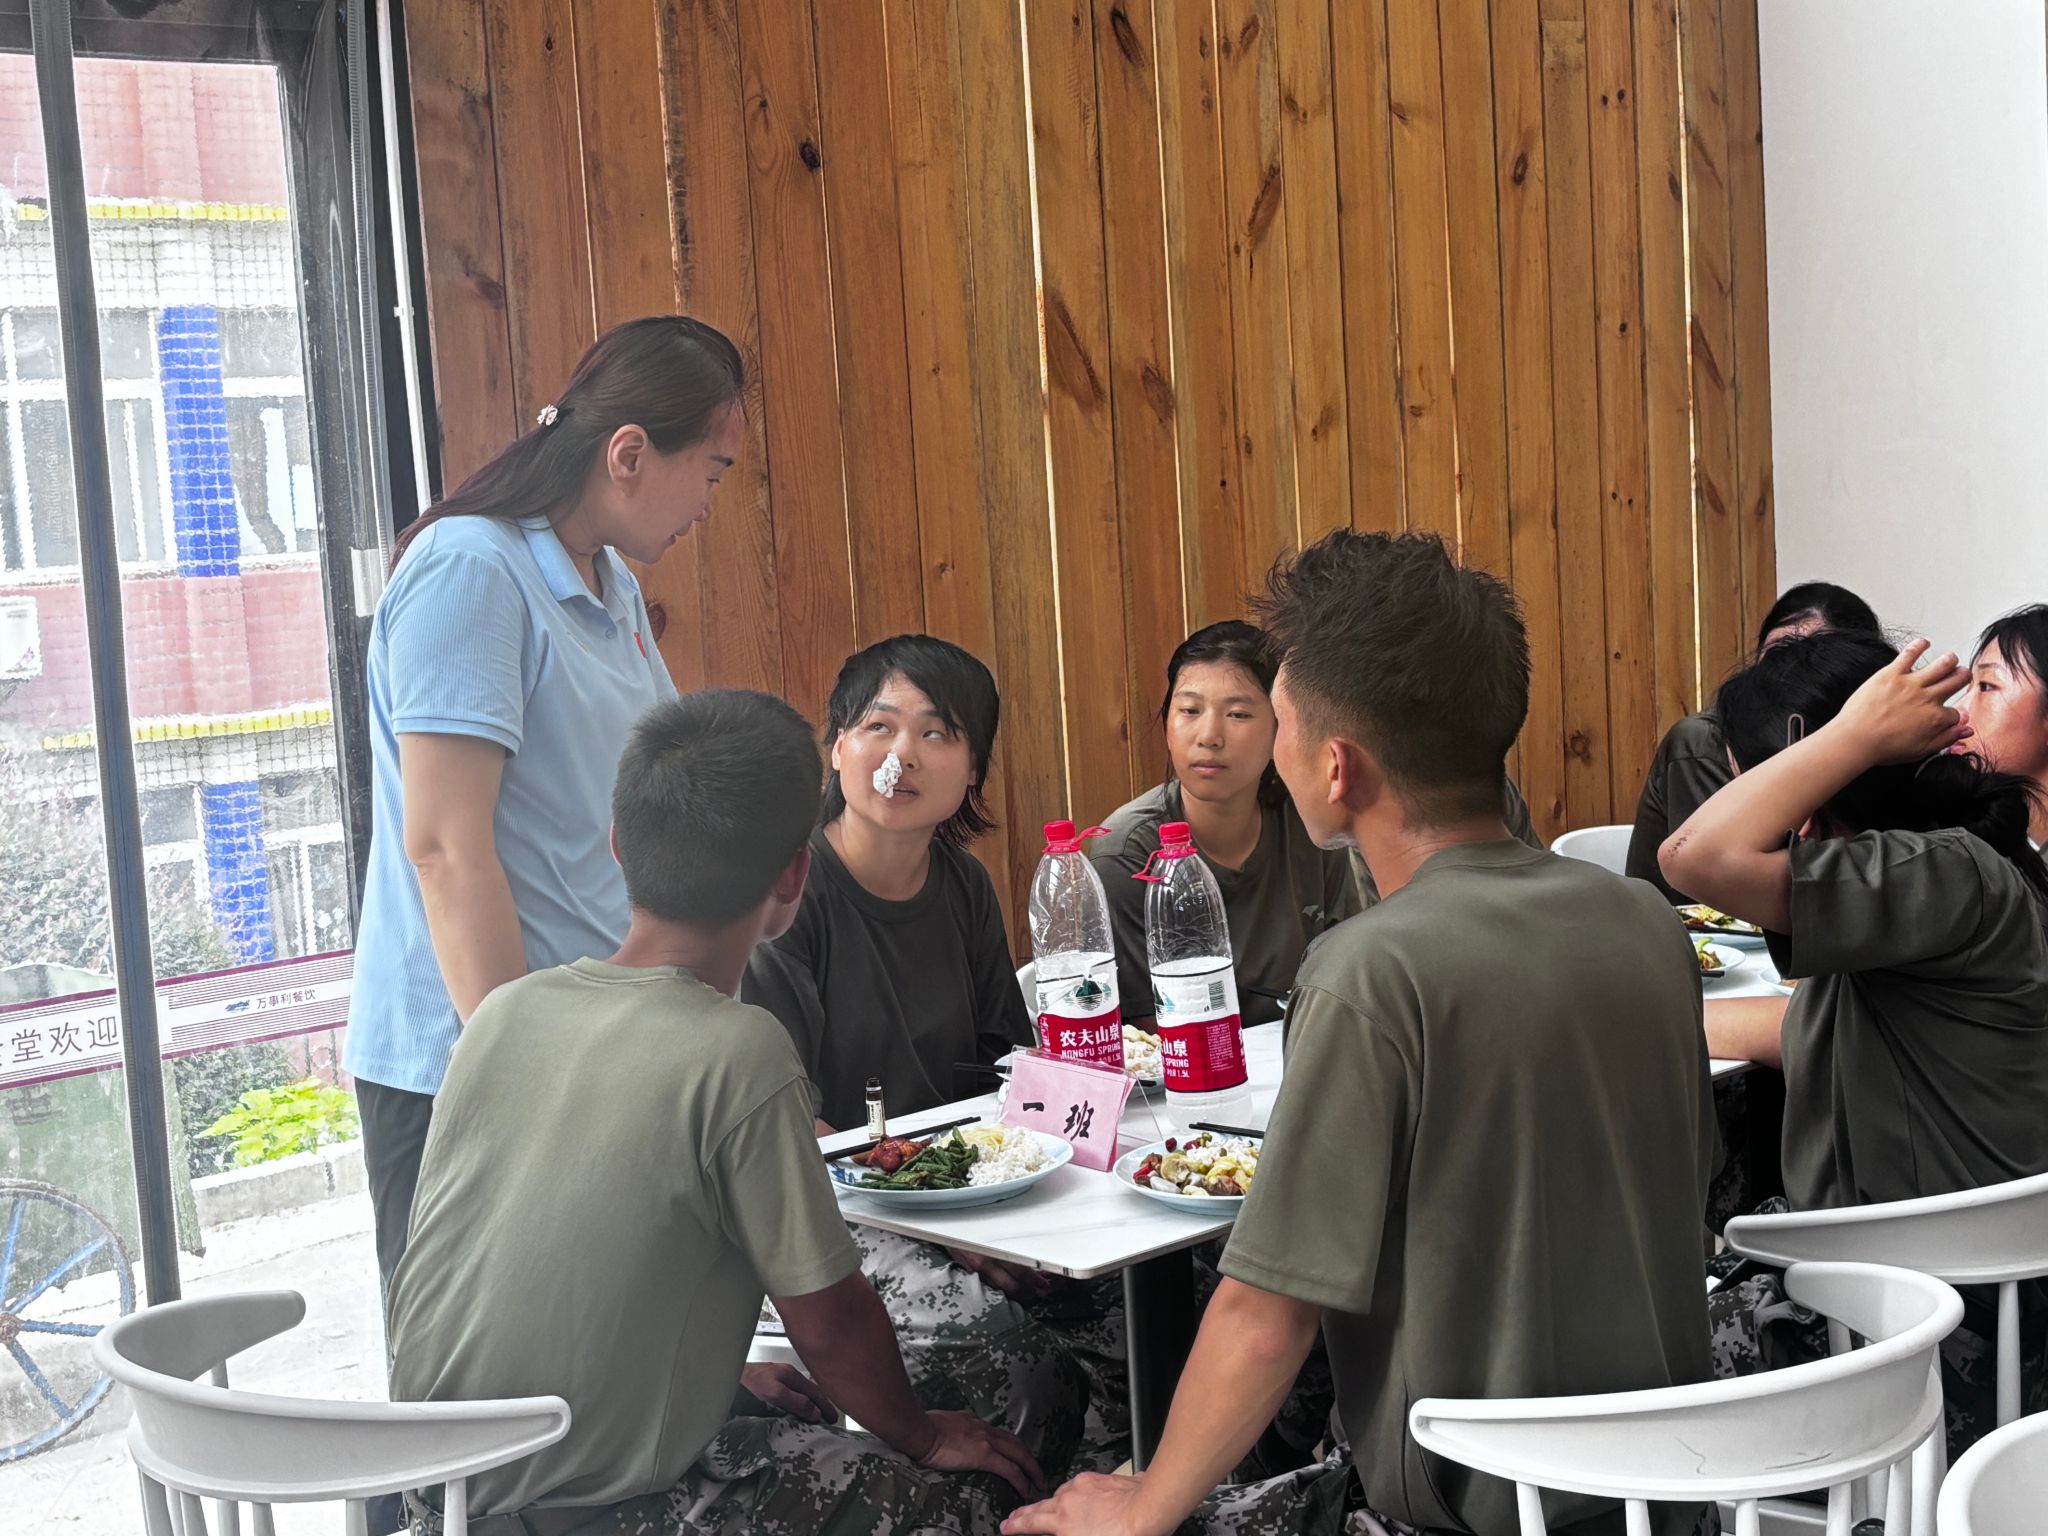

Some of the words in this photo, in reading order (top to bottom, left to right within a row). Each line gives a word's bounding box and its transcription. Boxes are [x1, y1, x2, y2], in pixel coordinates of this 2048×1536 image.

[0, 1016, 119, 1066] 堂欢迎
[1060, 1022, 1120, 1048] 农夫山泉
[1061, 1047, 1095, 1059] NONGFU
[1098, 1041, 1120, 1055] SPRING
[1161, 1037, 1188, 1057] 山泉
[1165, 1057, 1189, 1068] SPRING
[1023, 1100, 1094, 1141] 一班
